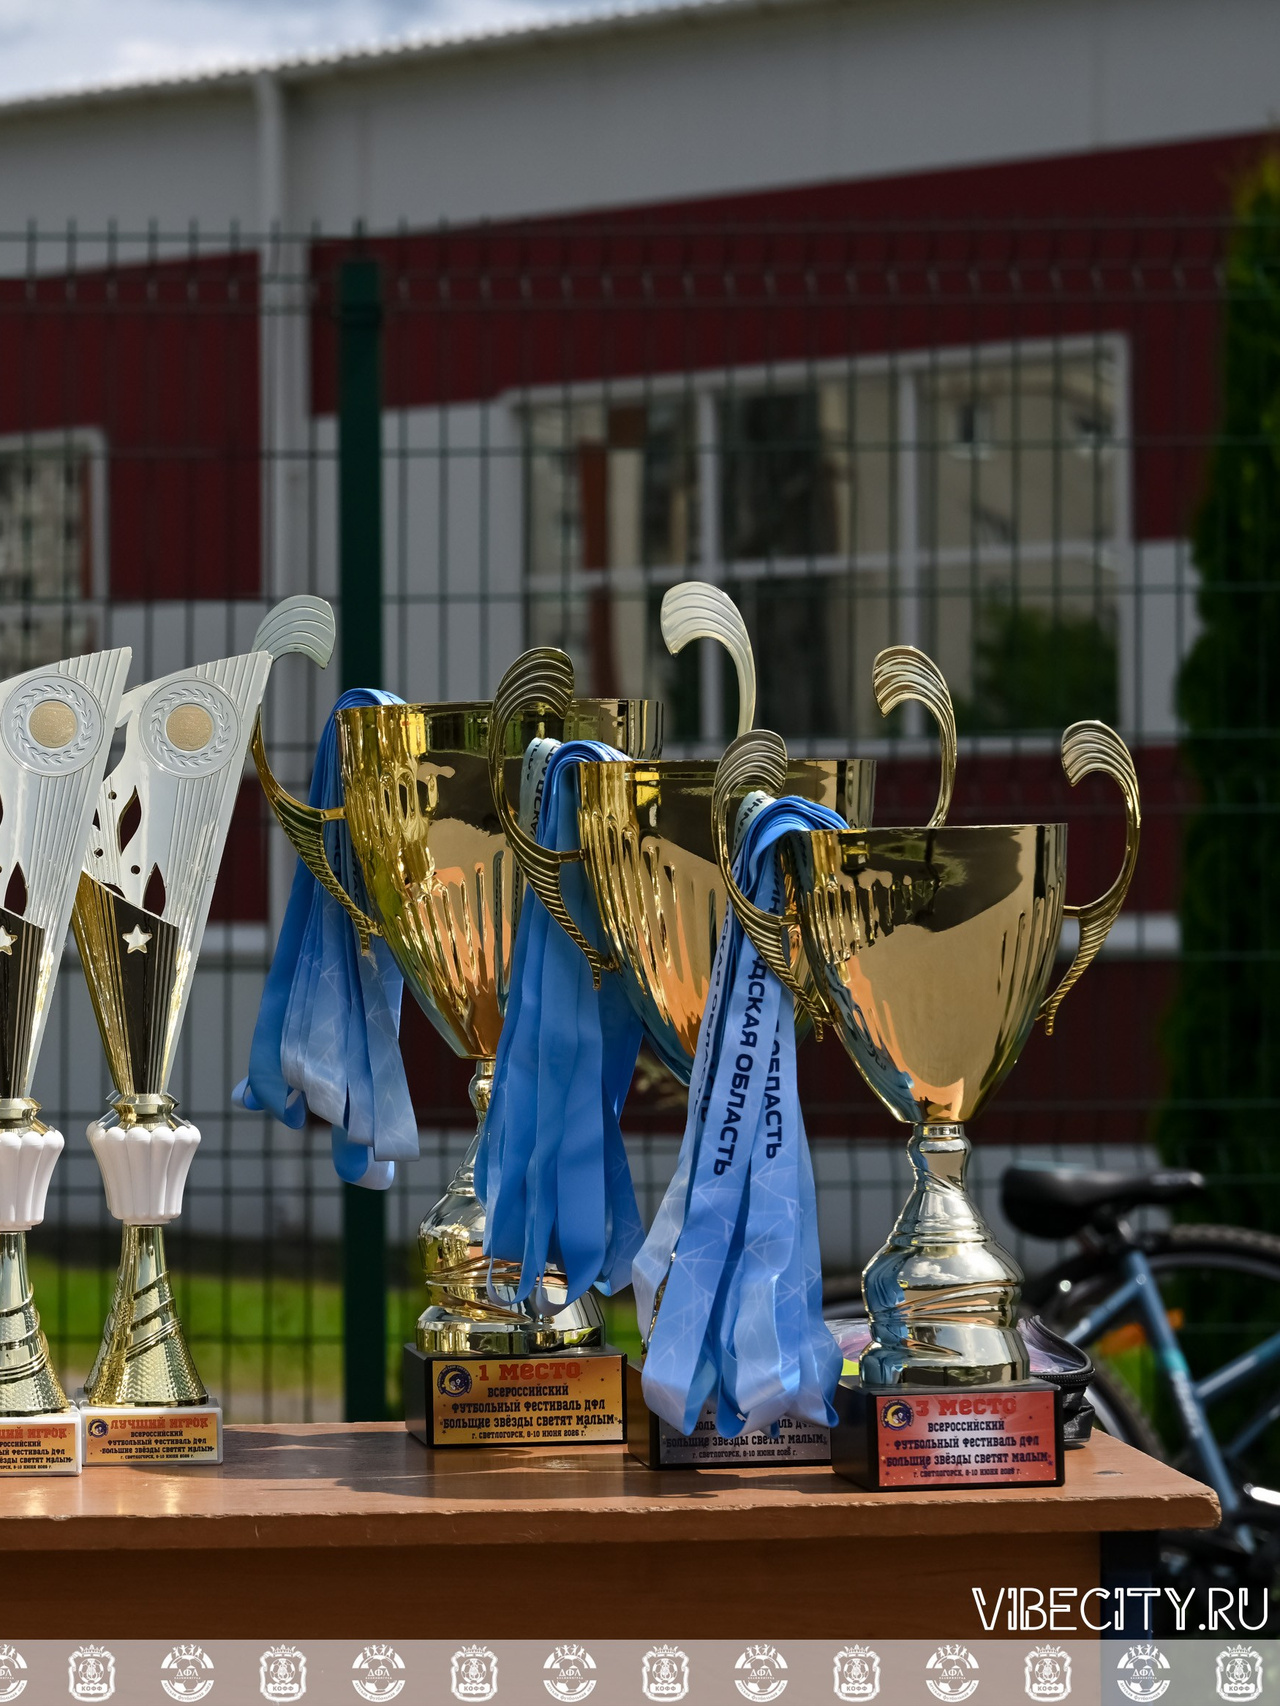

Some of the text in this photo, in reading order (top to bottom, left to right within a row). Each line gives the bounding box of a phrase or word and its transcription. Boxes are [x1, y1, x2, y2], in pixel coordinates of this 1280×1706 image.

[713, 1053, 753, 1176] ОБЛАСТЬ
[479, 1365, 489, 1381] 1
[487, 1383, 569, 1398] ВСЕРОССИЙСКИЙ
[451, 1399, 605, 1414] ФУТБОЛЬНЫЙ ФЕСТИВАЛЬ ДФЛ
[915, 1400, 930, 1417] 3
[169, 1418, 208, 1429] ИГРОК
[493, 1415, 533, 1428] ЗВЁЗДЫ
[536, 1416, 573, 1427] СВЕТЯТ
[927, 1417, 1005, 1433] ВСЕРОССИЙСКИЙ
[27, 1427, 67, 1439] ИГРОК
[893, 1435, 1039, 1450] ФУТБОЛЬНЫЙ ФЕСТИВАЛЬ ДФЛ
[934, 1451, 971, 1466] ЗВЁЗДЫ
[974, 1452, 1009, 1465] СВЕТЯТ
